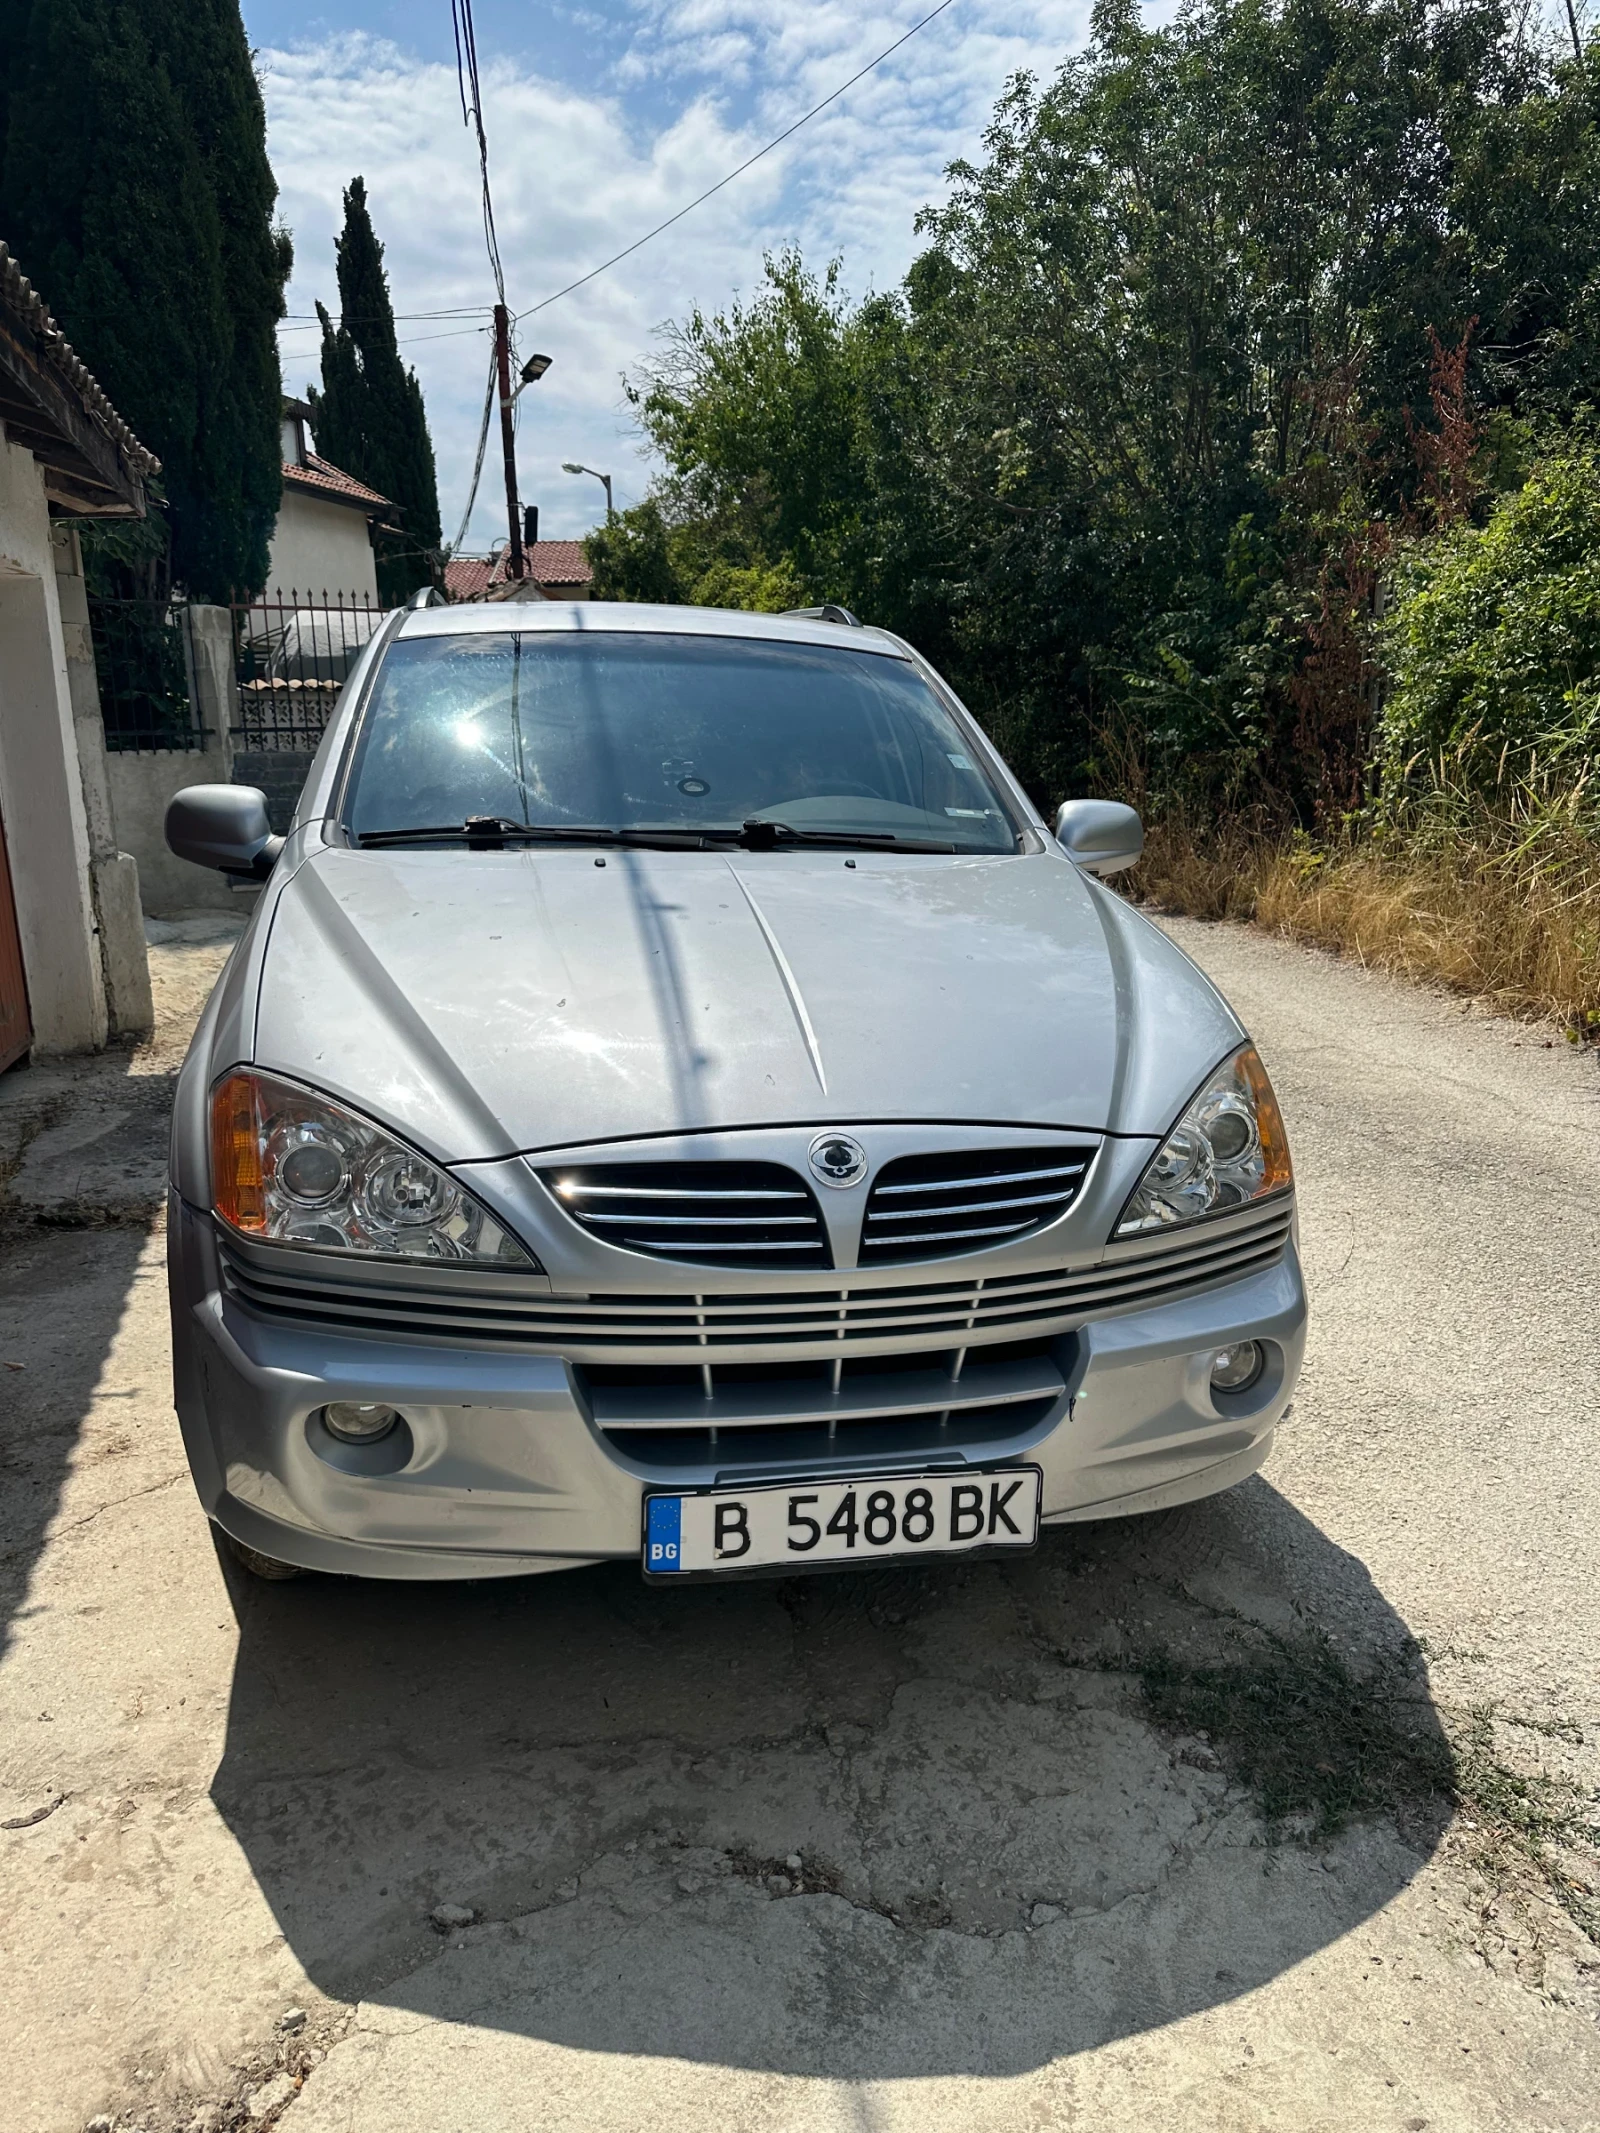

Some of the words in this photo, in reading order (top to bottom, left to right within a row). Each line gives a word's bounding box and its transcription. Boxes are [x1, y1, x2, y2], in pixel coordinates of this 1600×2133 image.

[714, 1502, 751, 1559] B
[788, 1488, 934, 1551] 5488
[950, 1480, 1024, 1541] BK
[651, 1543, 677, 1560] BG
